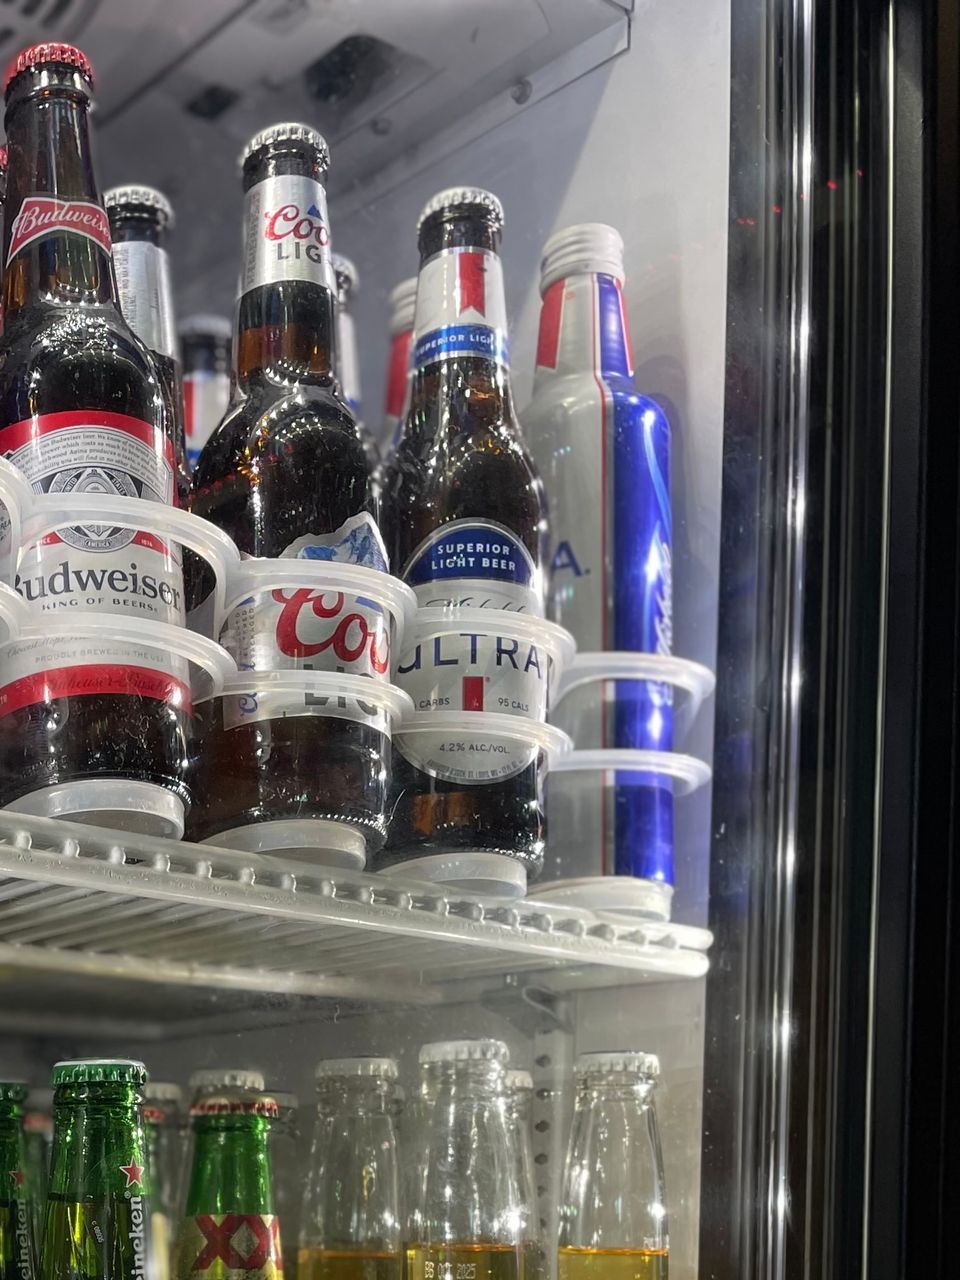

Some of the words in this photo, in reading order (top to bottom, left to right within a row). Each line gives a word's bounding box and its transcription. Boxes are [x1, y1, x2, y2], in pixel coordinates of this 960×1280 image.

[437, 543, 510, 557] SUPERIOR
[431, 557, 475, 570] LIGHT
[482, 558, 517, 571] BEER
[42, 598, 78, 611] KING
[86, 597, 103, 606] OF
[35, 650, 77, 664] PROUDLY
[132, 650, 149, 660] THE
[420, 697, 450, 709] CARBS
[497, 697, 510, 707] 95
[511, 700, 529, 712] CALS
[439, 743, 466, 752] 4.2%
